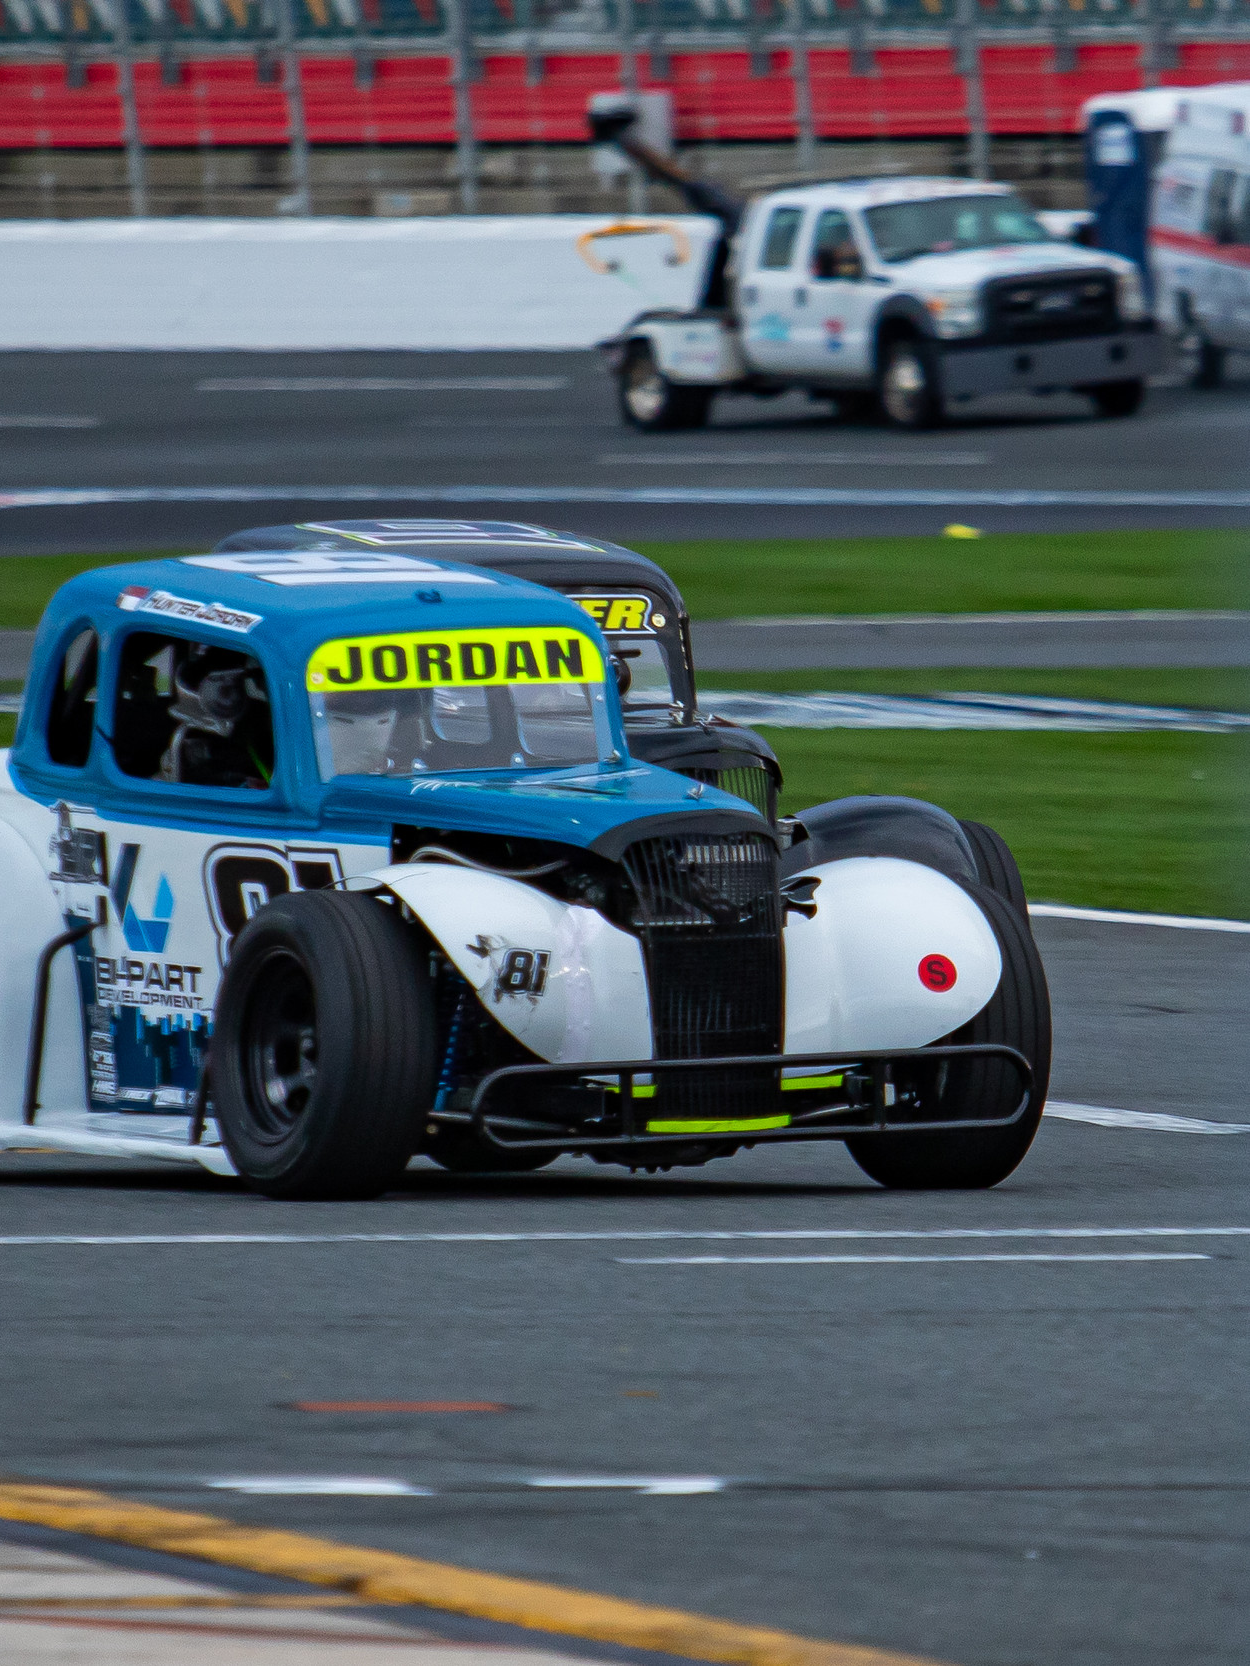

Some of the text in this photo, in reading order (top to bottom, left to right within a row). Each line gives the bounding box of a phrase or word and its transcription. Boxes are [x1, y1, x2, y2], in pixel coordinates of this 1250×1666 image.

[573, 599, 648, 629] ER
[326, 639, 584, 685] JORDAN
[499, 948, 551, 997] 81
[926, 960, 948, 986] S
